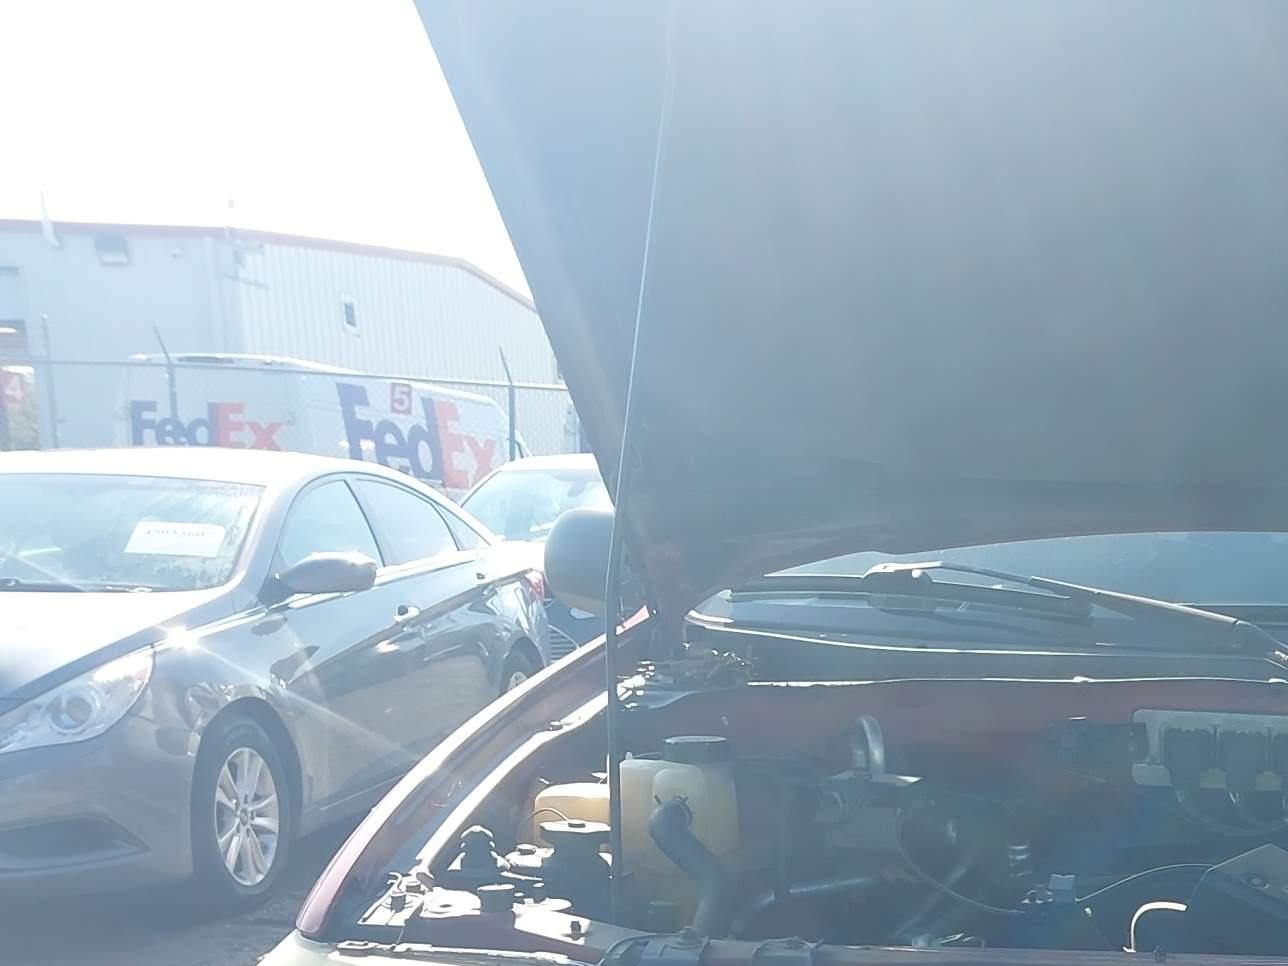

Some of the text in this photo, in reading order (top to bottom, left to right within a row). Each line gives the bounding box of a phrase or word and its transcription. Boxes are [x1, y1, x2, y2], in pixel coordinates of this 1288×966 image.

[392, 384, 413, 412] 5
[131, 400, 284, 452] FedEx
[336, 382, 497, 490] FedEx
